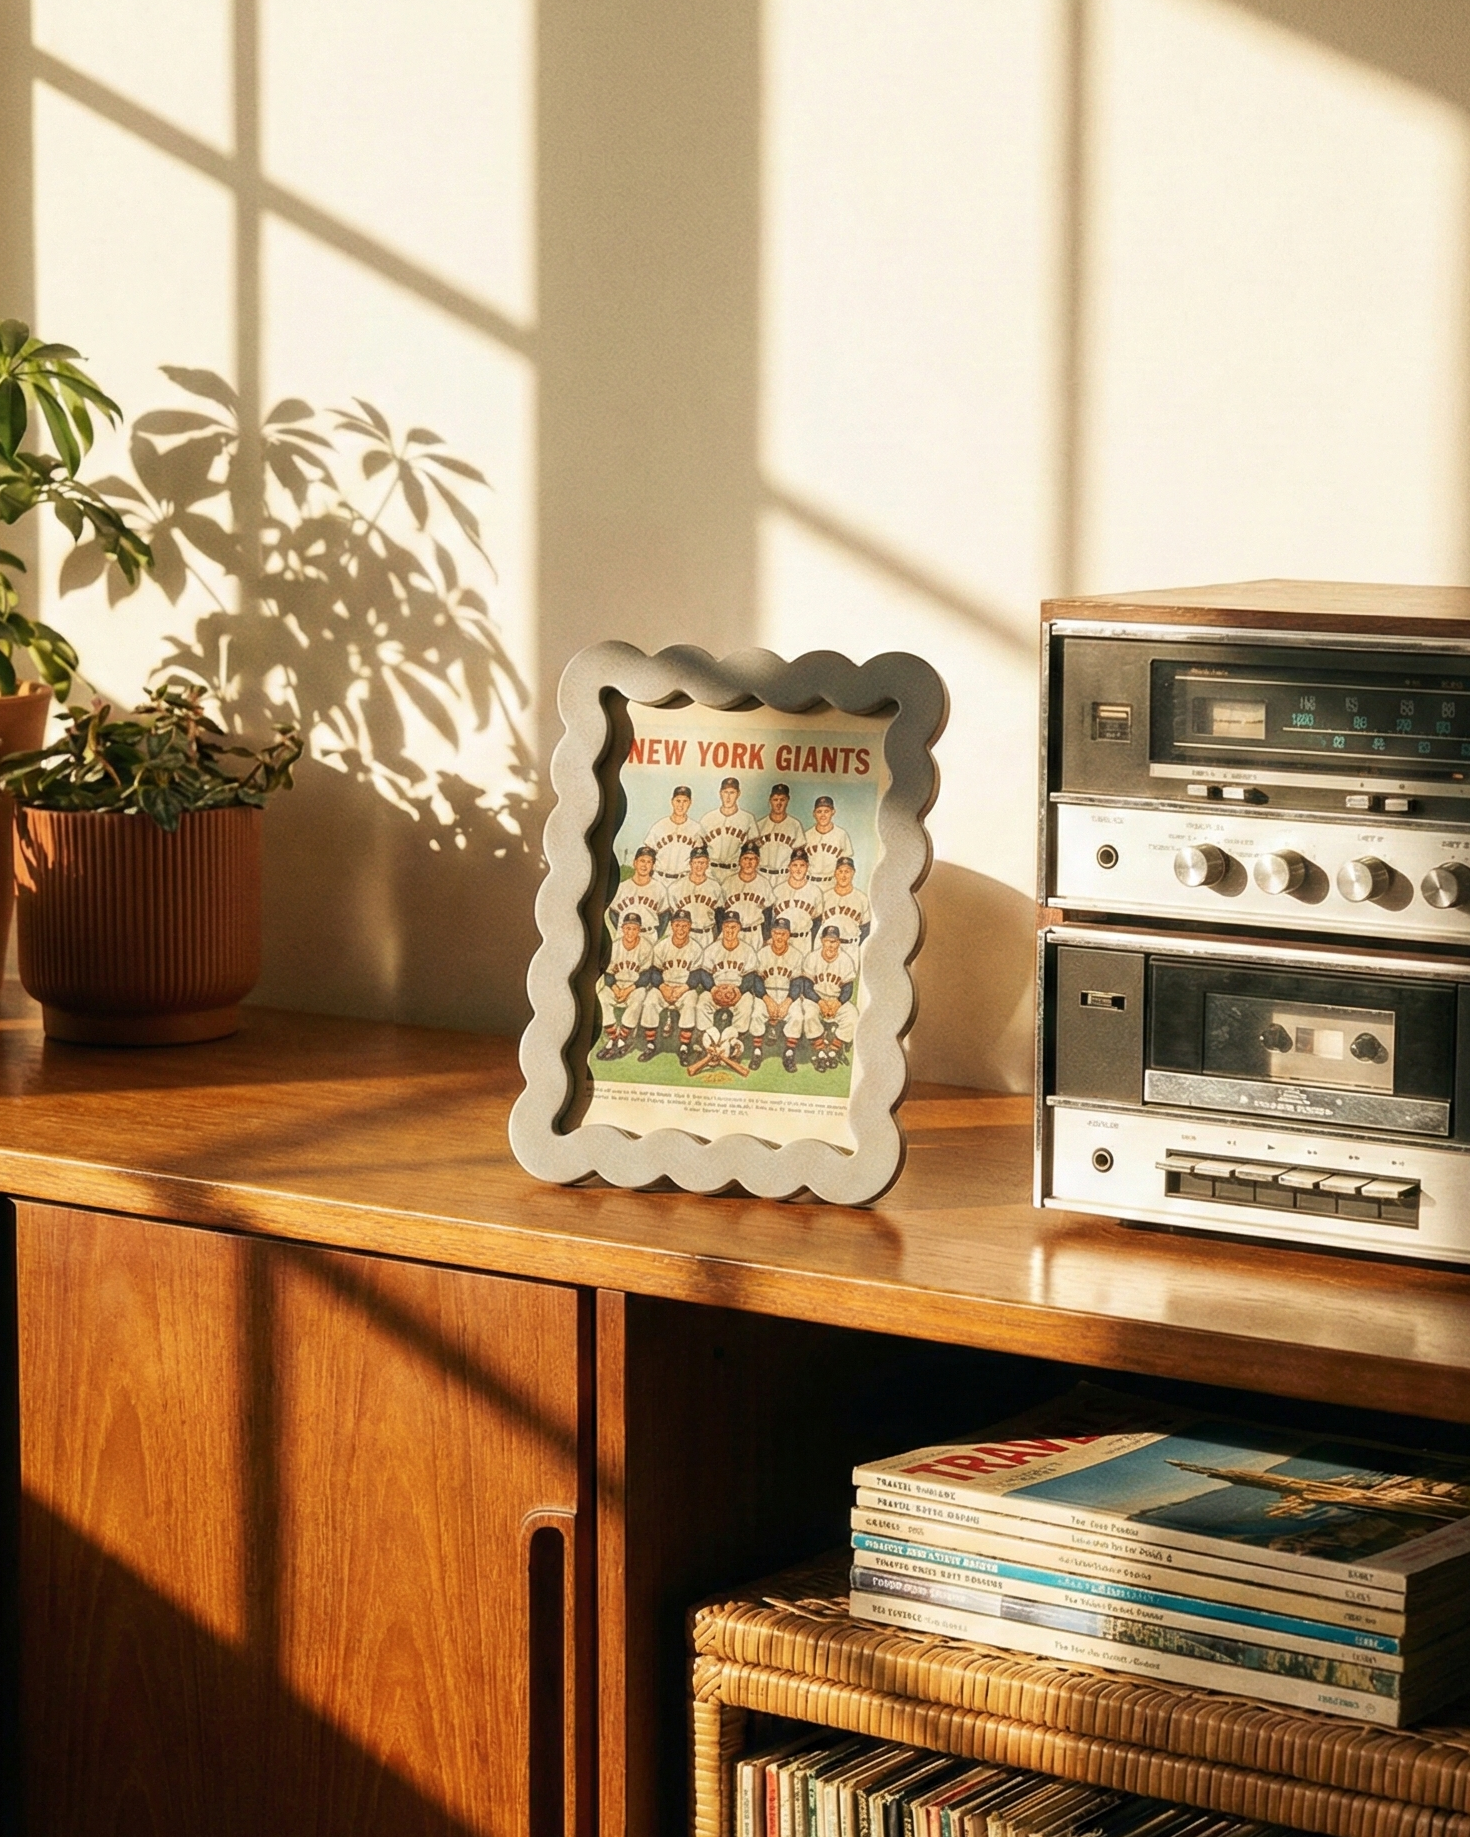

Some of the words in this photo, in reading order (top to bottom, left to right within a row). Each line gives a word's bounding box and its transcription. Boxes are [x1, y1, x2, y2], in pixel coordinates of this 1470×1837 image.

[628, 738, 687, 765] NEW
[697, 740, 765, 770] YORK
[775, 744, 870, 775] GIANTS
